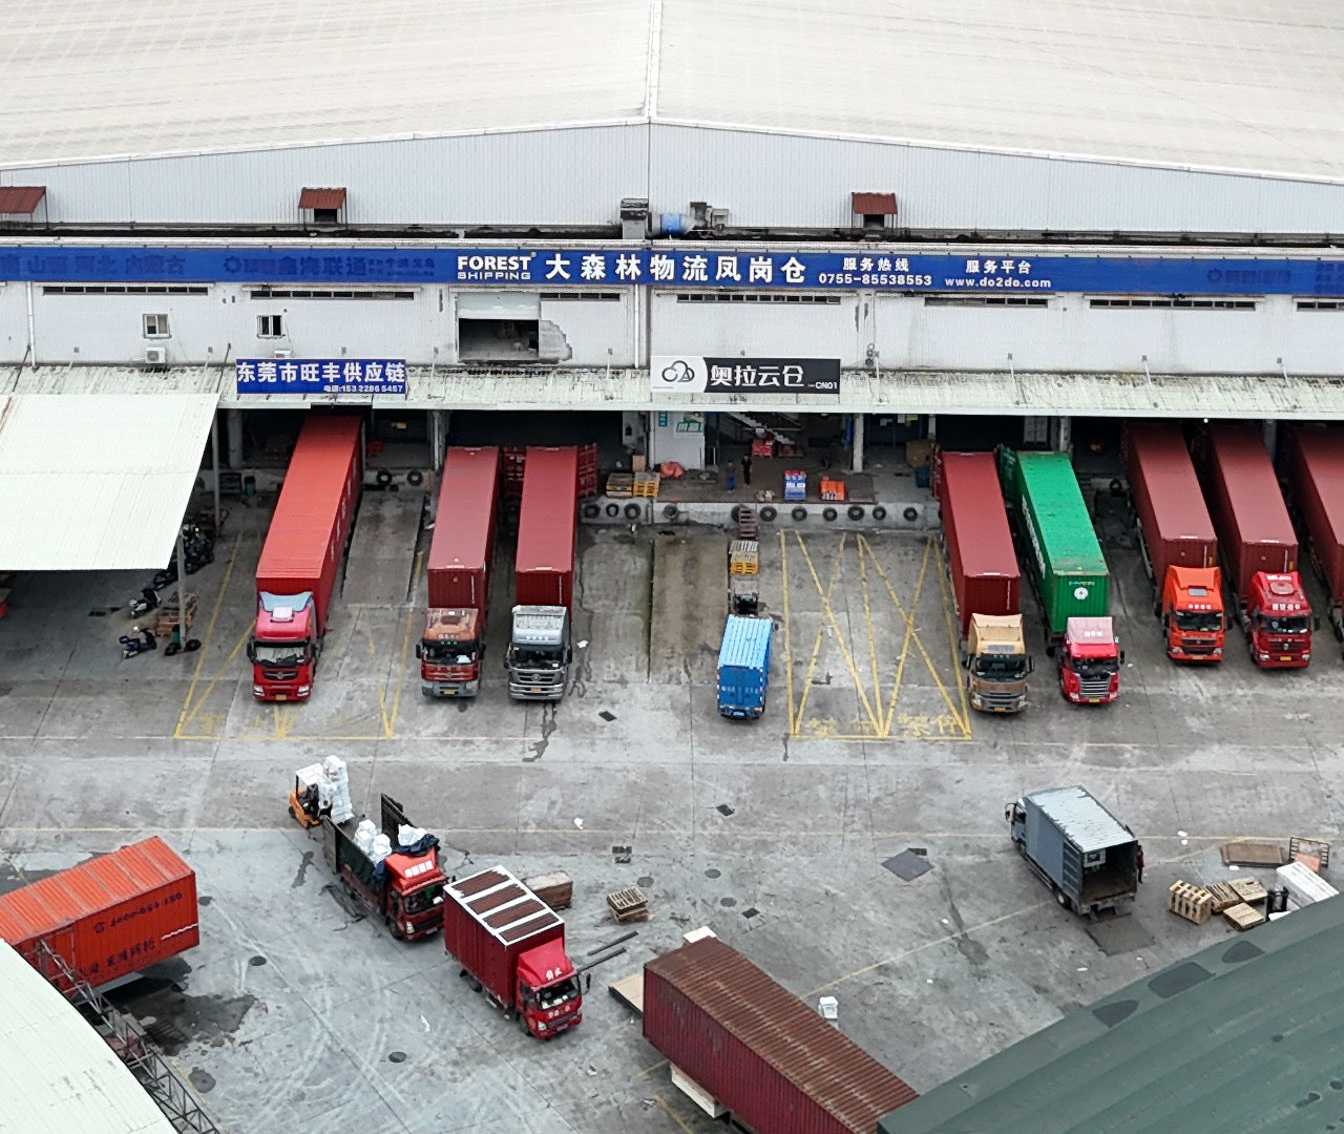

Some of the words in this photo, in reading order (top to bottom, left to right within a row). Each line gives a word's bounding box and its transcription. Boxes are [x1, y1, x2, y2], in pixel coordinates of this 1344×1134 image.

[457, 255, 531, 270] FOREST
[545, 253, 807, 283] 大森林物流凤岗仓
[843, 257, 910, 272] 服务热线
[965, 260, 1032, 274] 服务平台
[457, 271, 531, 280] SHIPPING
[818, 273, 933, 286] 0755-85538553
[944, 277, 1052, 288] www.do2do.com
[237, 361, 405, 383] 东莞市旺丰供应链
[710, 364, 805, 387] 奥拉云仓
